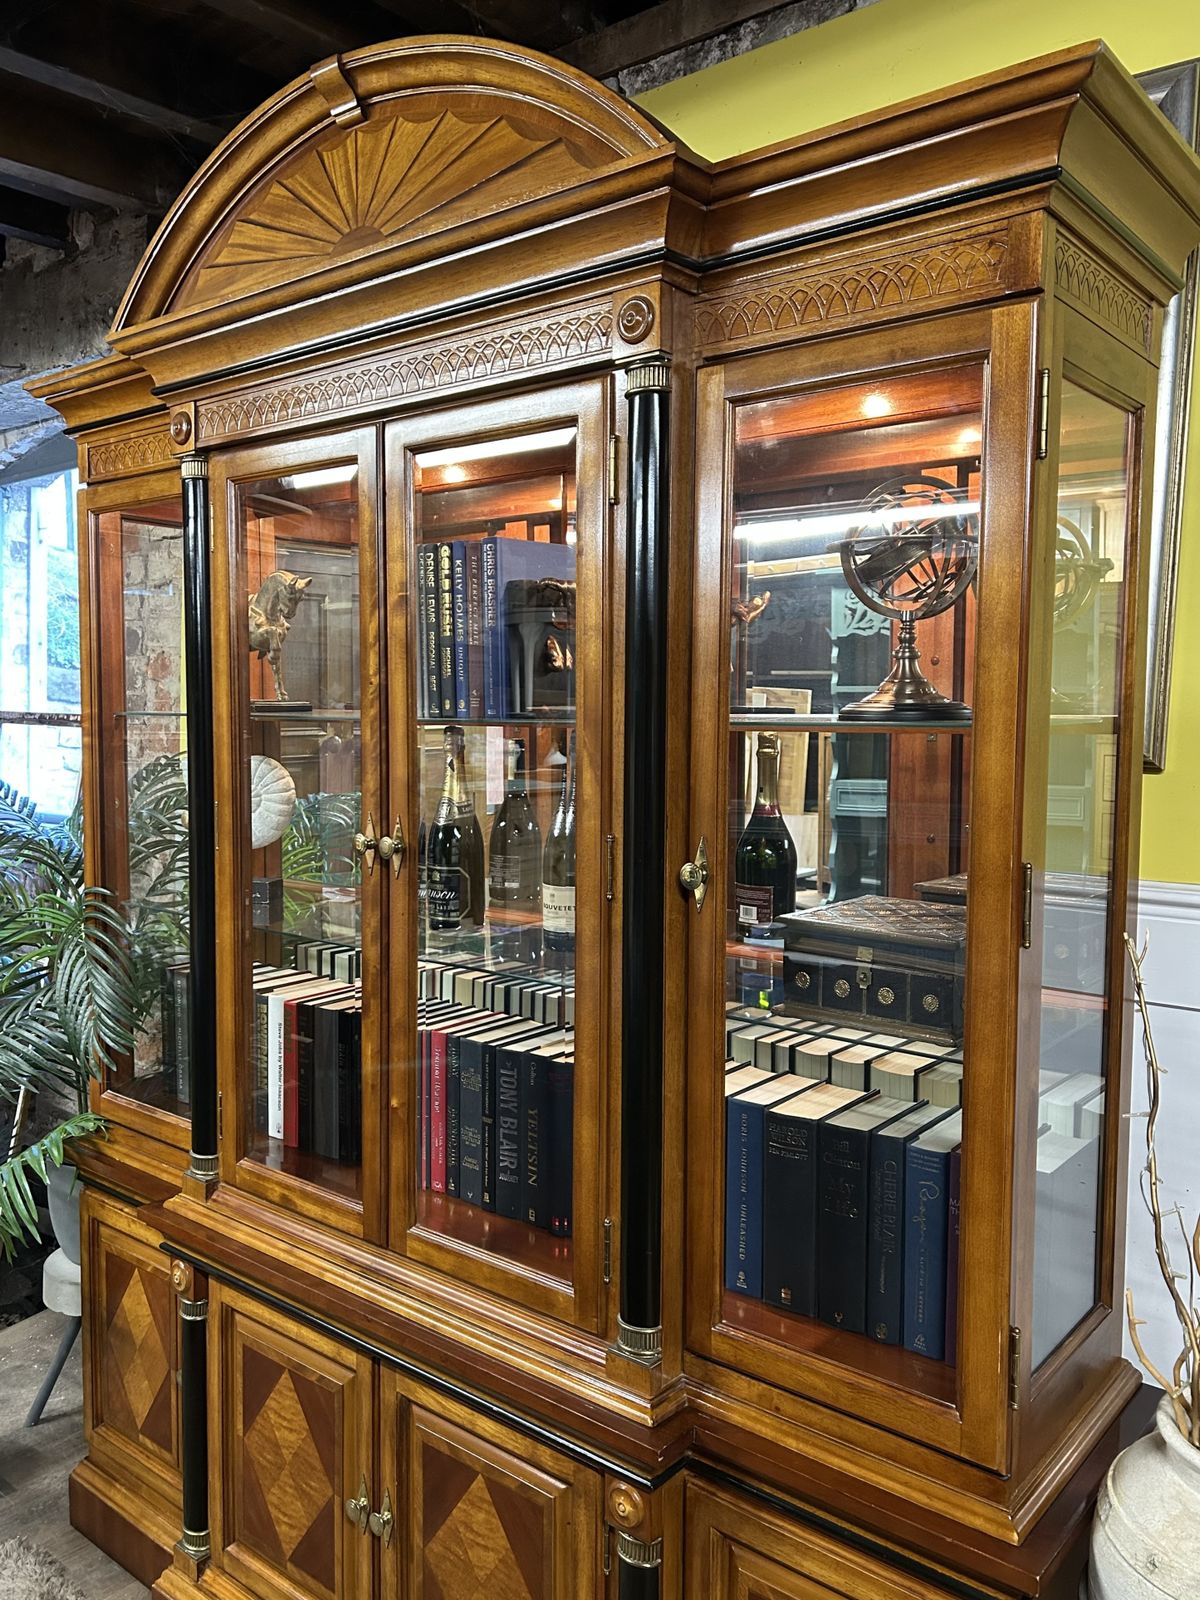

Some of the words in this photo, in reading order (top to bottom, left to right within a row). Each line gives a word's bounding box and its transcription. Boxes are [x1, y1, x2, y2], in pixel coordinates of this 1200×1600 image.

[425, 552, 435, 588] DENISE
[441, 545, 451, 591] GOLD
[455, 560, 463, 591] KELLY
[487, 543, 495, 576] CHRIS
[427, 594, 436, 623] LEWIS
[442, 592, 452, 637] RUSH
[456, 594, 464, 642] HOLMES
[488, 578, 496, 627] BRASHER
[260, 1003, 268, 1090] BOWERMAN
[500, 1068, 518, 1112] TONY
[500, 1116, 518, 1169] BLAIR
[528, 1108, 538, 1187] YELTSIN
[769, 1122, 808, 1138] HAROLD
[770, 1131, 807, 1146] WILSON
[833, 1139, 850, 1153] Bill
[740, 1148, 748, 1193] JOHNSON
[823, 1152, 861, 1170] Clinton
[883, 1160, 897, 1211] CHERIE
[739, 1204, 747, 1260] UNLEASHED
[882, 1214, 897, 1255] BLAIR
